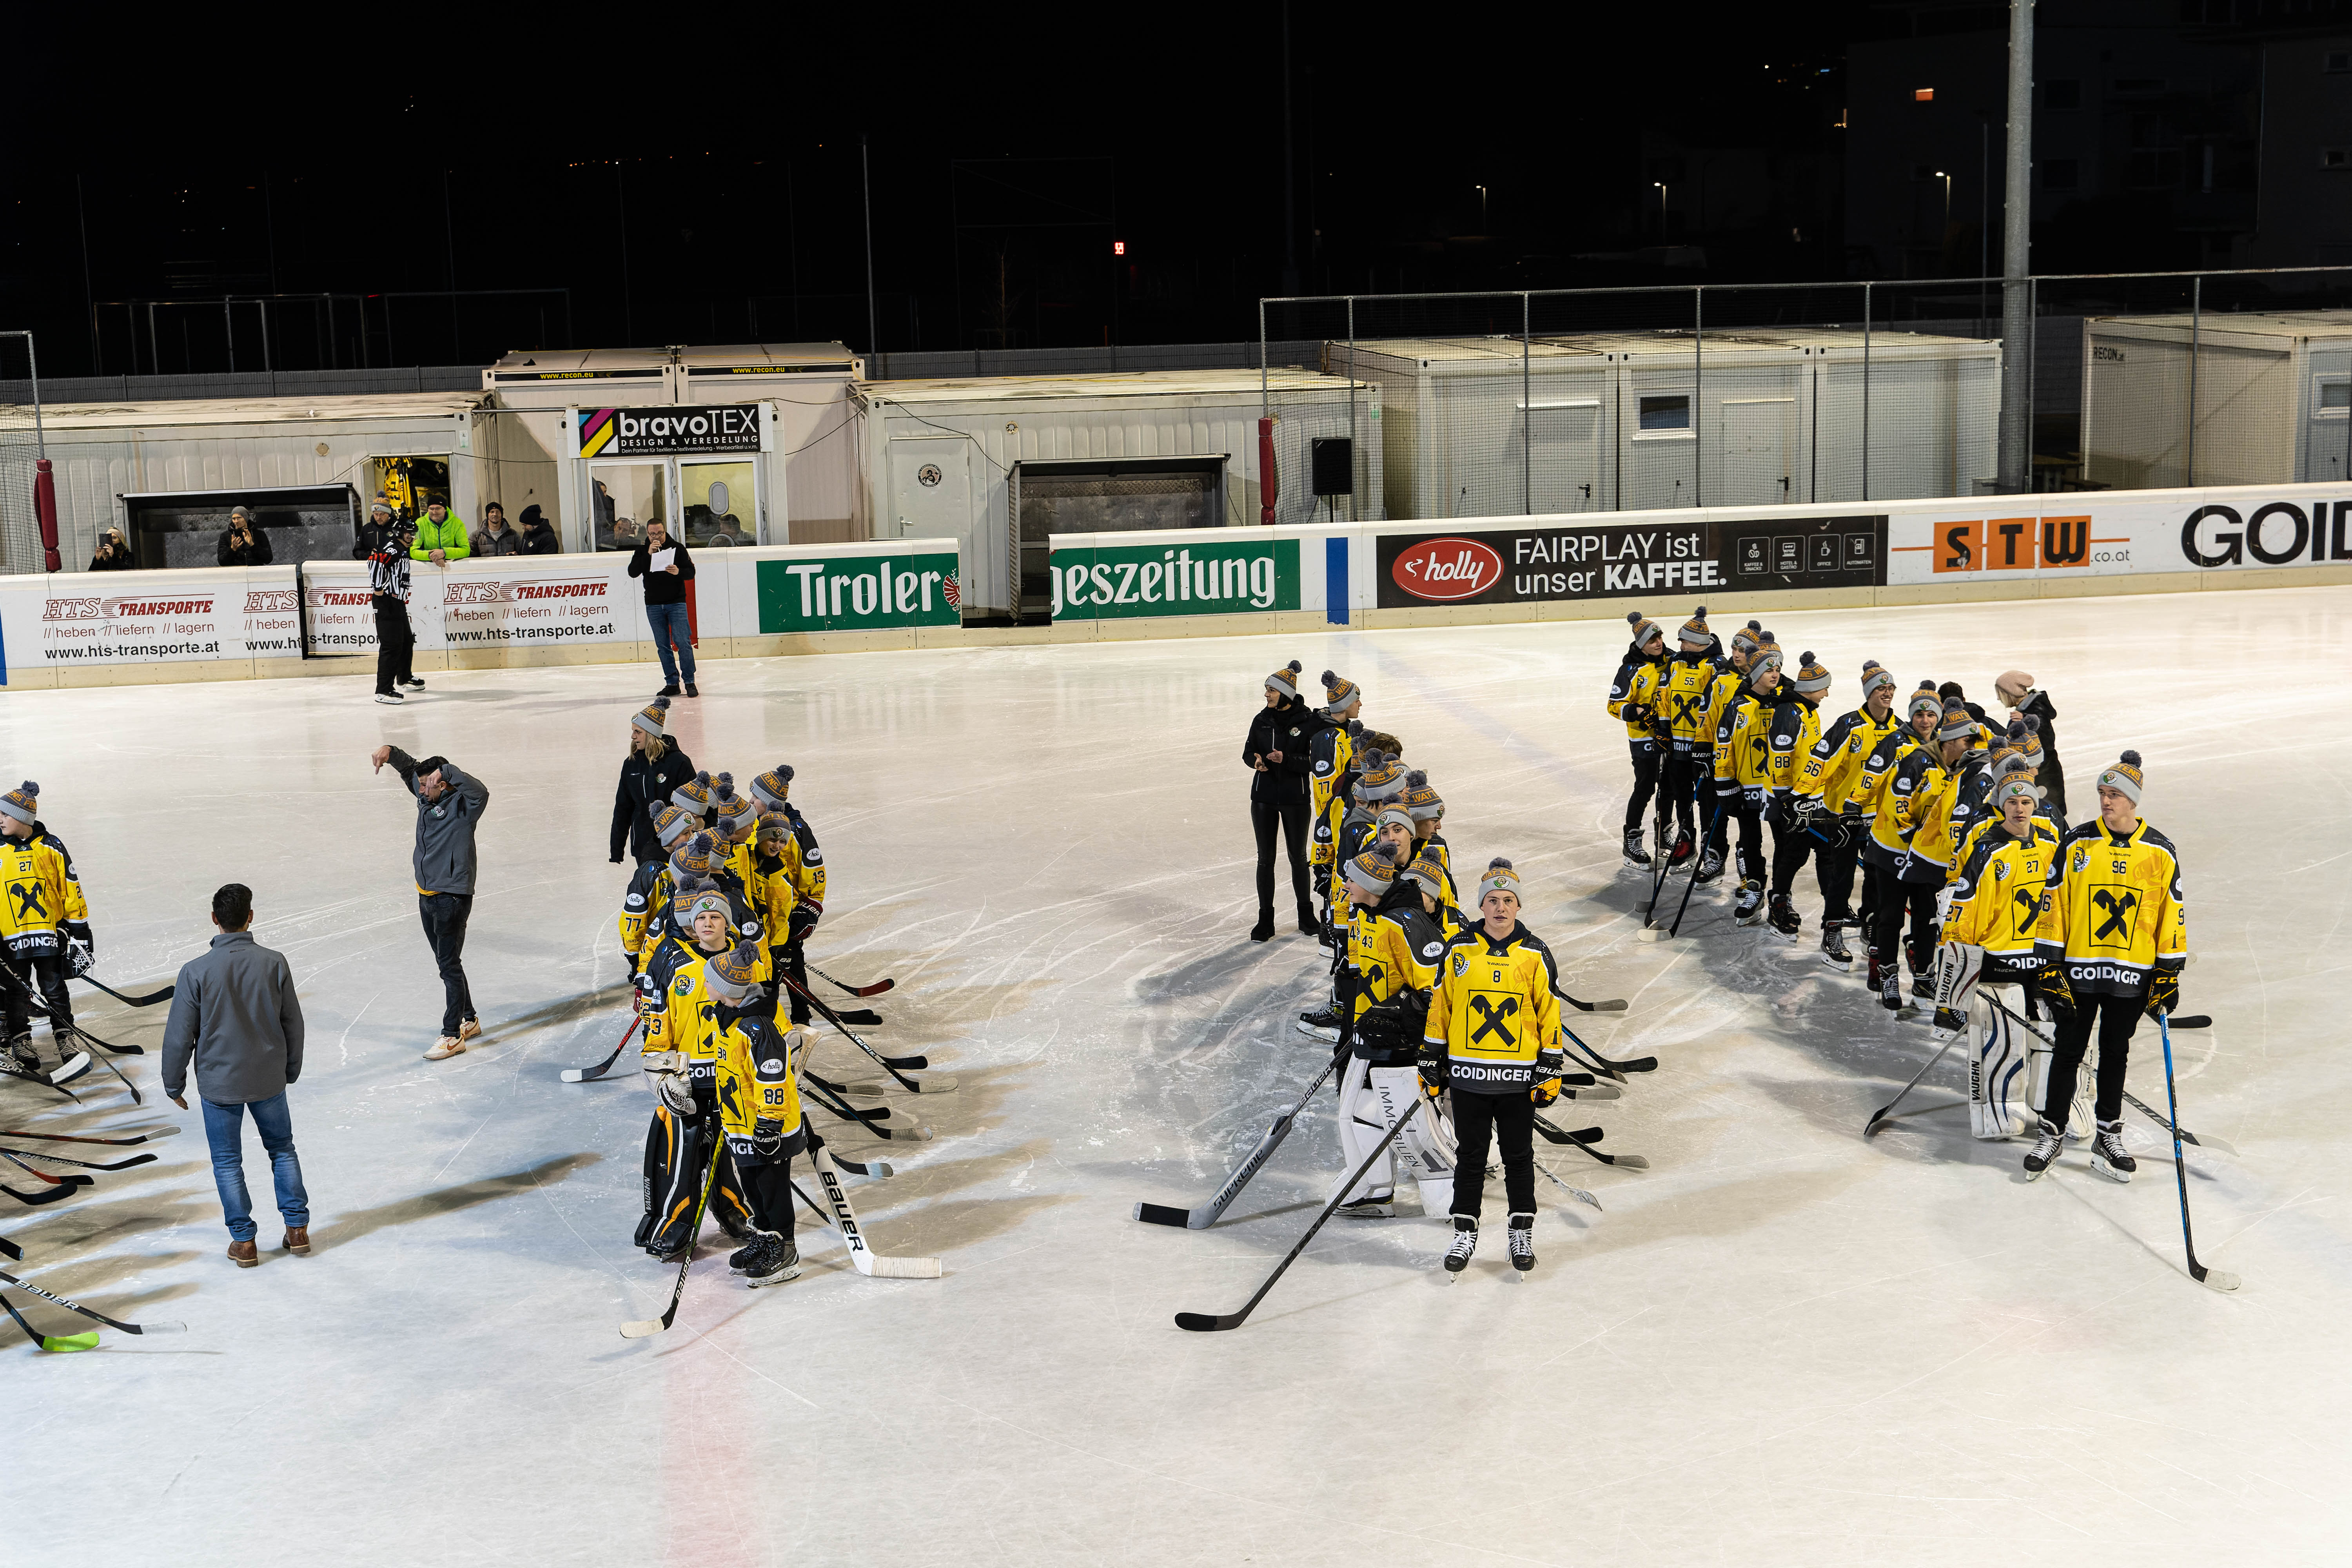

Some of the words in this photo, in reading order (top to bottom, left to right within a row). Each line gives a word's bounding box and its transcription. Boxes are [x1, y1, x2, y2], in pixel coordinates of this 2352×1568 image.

[540, 371, 593, 380] www.recon.eu
[733, 365, 785, 375] www.recon.eu
[619, 409, 757, 437] bravoTEX
[621, 438, 664, 446] DESIGN
[684, 435, 758, 445] VEREDELUNG
[1515, 533, 1657, 564] FAIRPLAY
[1666, 532, 1700, 558] ist
[1946, 521, 2088, 568] STW
[1425, 550, 1485, 588] holly
[1515, 570, 1596, 595] unser
[1604, 560, 1727, 590] KAFFEE.
[444, 581, 499, 603] HTS
[517, 583, 608, 599] TRANSPORTE
[786, 561, 941, 617] Tiroler
[43, 598, 101, 619] HTS
[119, 600, 214, 616] TRANSPORTE
[244, 590, 299, 611] HTS
[257, 619, 295, 630] heben
[321, 613, 354, 624] liefern
[455, 610, 494, 621] heben
[514, 607, 551, 618] liefern
[571, 605, 608, 618] lagern
[56, 627, 95, 638] heben
[116, 624, 154, 635] liefern
[175, 622, 214, 636] lagern
[445, 622, 613, 642] www.hts-transporte.at
[45, 641, 220, 659] www.hts-transporte.at
[1684, 677, 1695, 686] 55
[1774, 756, 1791, 768] 88
[1804, 760, 1822, 777] 66
[1860, 775, 1874, 789] 16
[19, 861, 32, 872] 27
[2026, 860, 2039, 873] 27
[2112, 860, 2127, 875] 96
[813, 869, 825, 884] 13
[625, 917, 642, 932] 77
[1362, 935, 1373, 949] 43
[804, 962, 838, 984] BAUER
[1493, 970, 1501, 983] 8
[1938, 962, 1955, 1004] VAUGHN
[768, 1062, 780, 1071] holly
[1451, 1065, 1531, 1082] GOIDINGER
[1971, 1060, 1981, 1101] VAUGHN
[764, 1087, 784, 1105] 88
[1213, 1149, 1265, 1211] SUPREME
[821, 1171, 864, 1252] BAUER
[771, 1262, 782, 1271] CCM
[14, 1279, 80, 1311] BAUER
